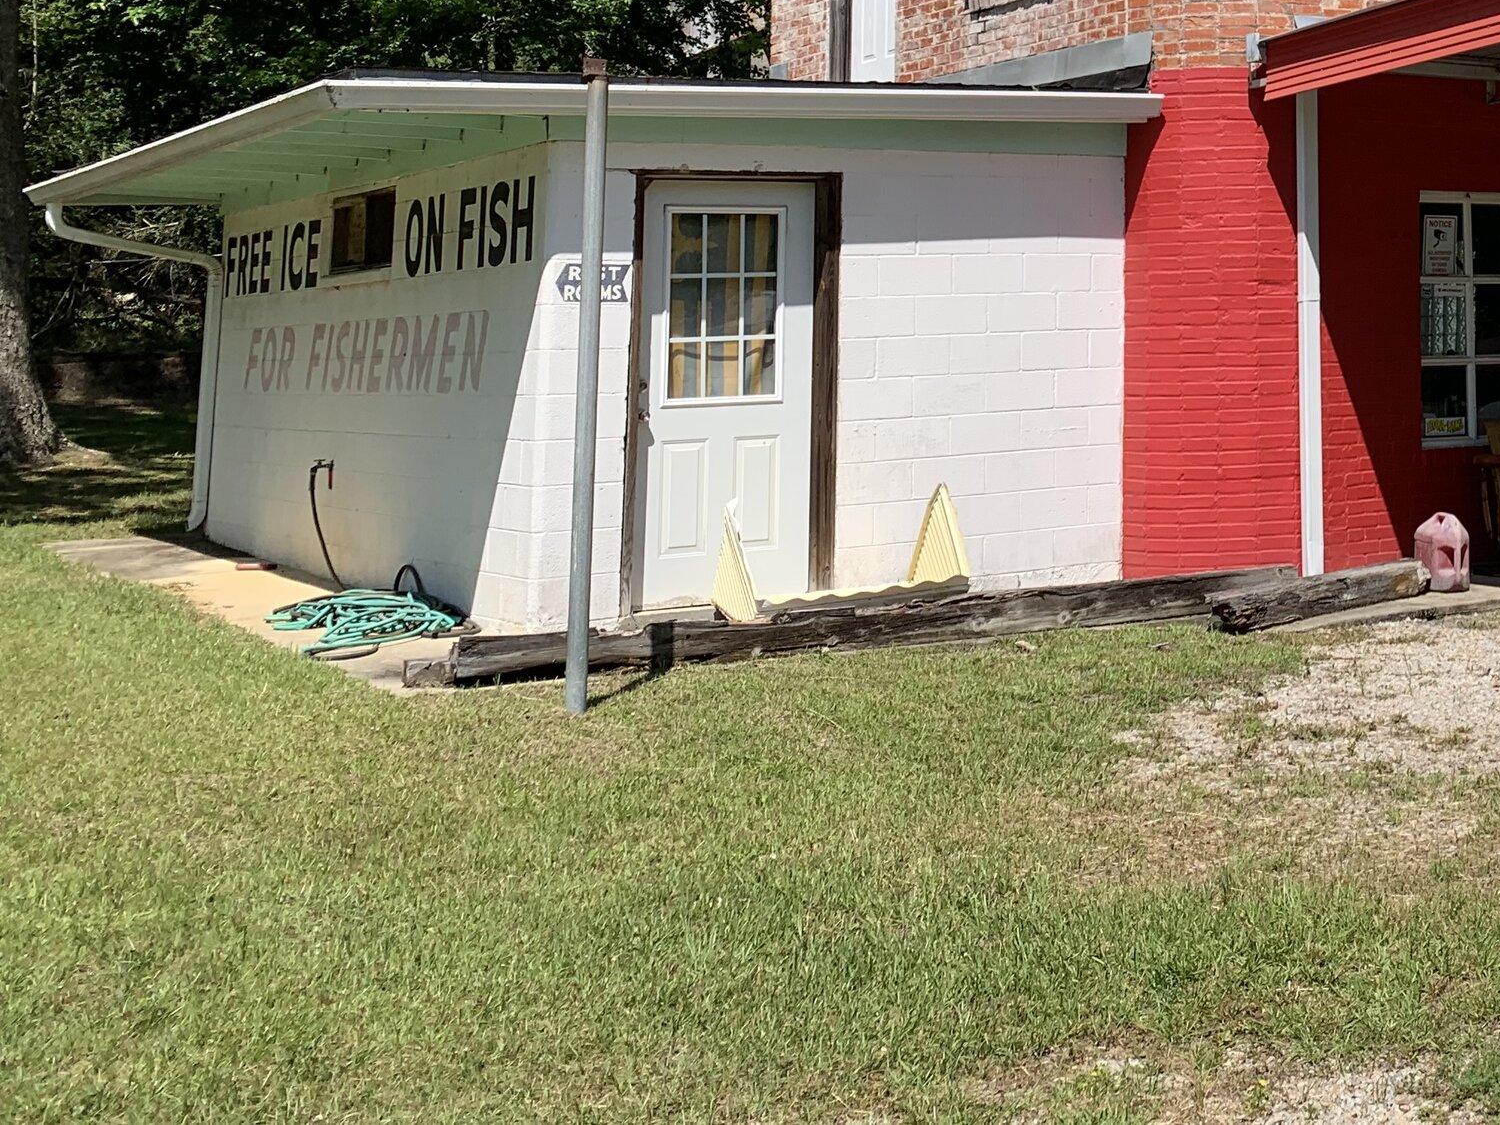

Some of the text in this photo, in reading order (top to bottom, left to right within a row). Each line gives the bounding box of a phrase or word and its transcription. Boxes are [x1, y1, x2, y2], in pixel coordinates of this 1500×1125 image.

[1429, 220, 1452, 228] NOTICE
[225, 176, 536, 298] FREE ICE ON FISH
[568, 266, 621, 281] RT
[563, 284, 622, 301] RMS
[243, 309, 490, 394] FOR FISHERMEN
